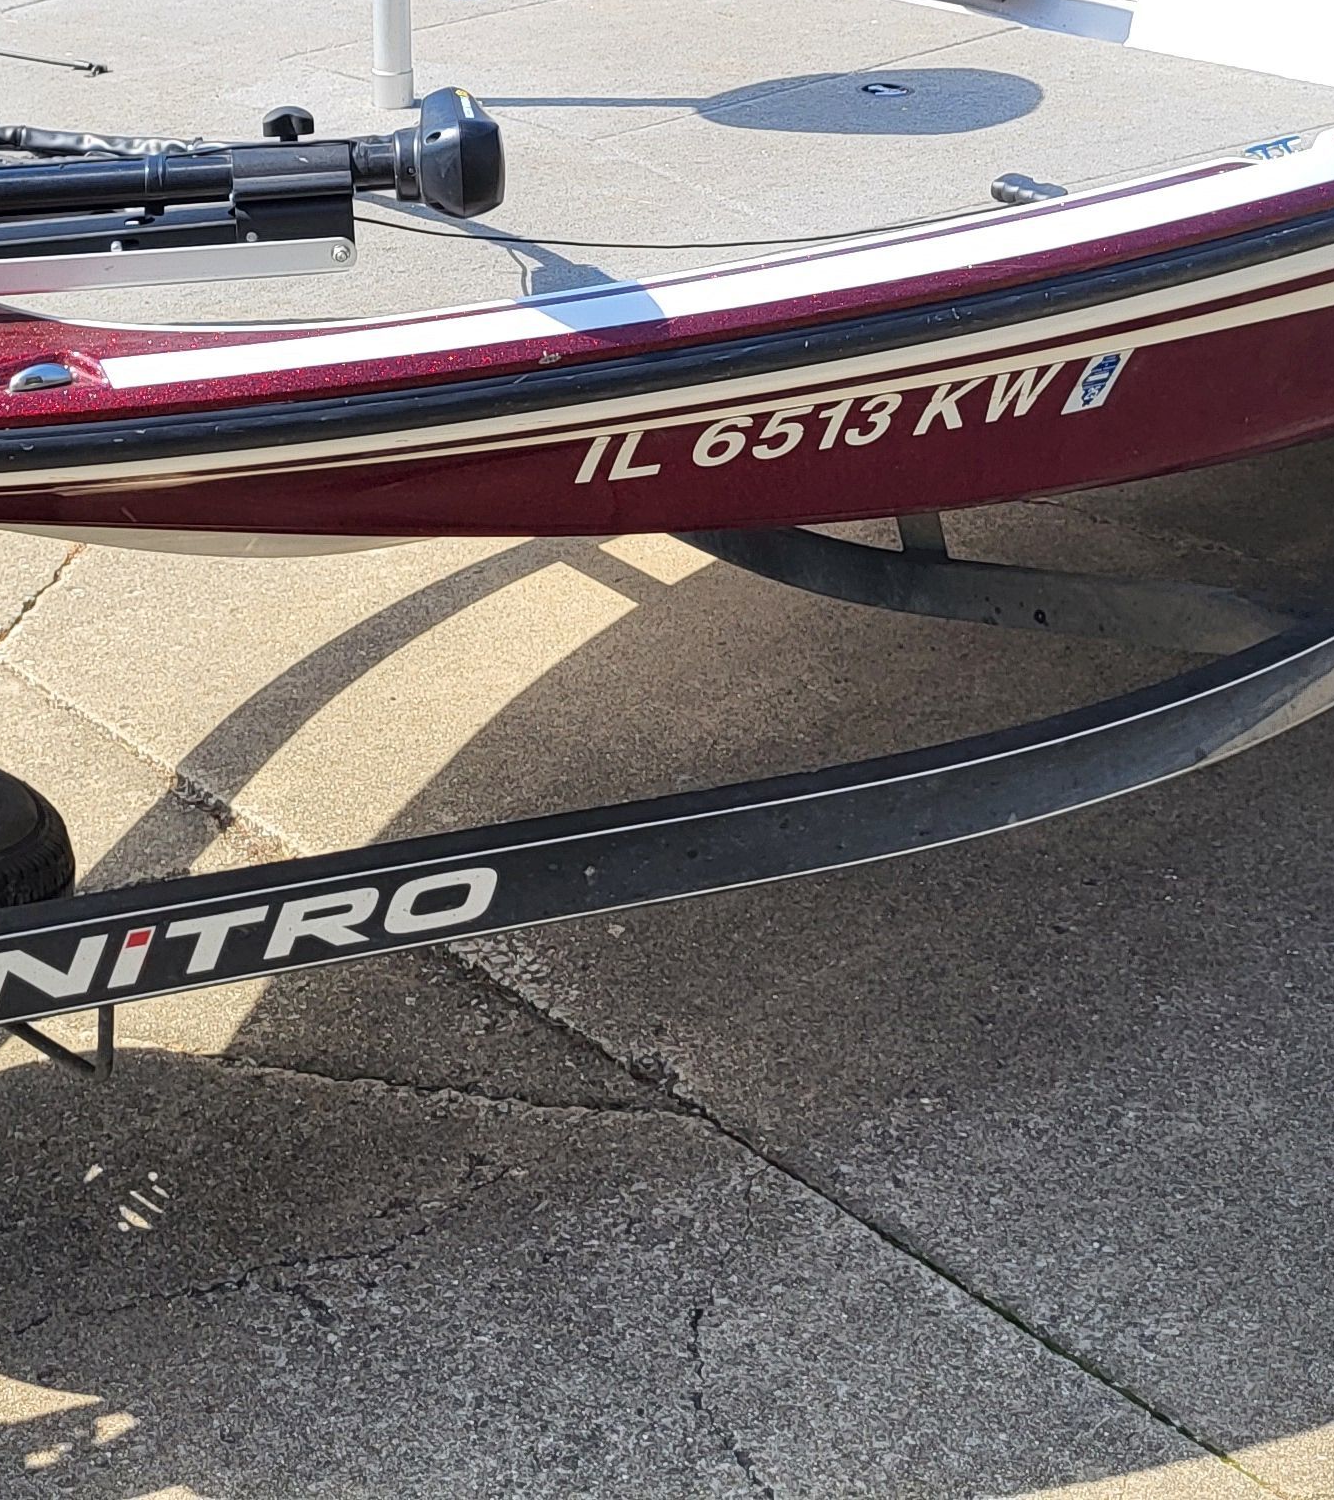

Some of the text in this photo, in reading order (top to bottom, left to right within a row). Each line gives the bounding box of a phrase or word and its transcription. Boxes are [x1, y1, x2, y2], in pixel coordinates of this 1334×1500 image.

[575, 431, 661, 485] IL
[692, 393, 902, 467] 6513
[913, 361, 1066, 436] KW
